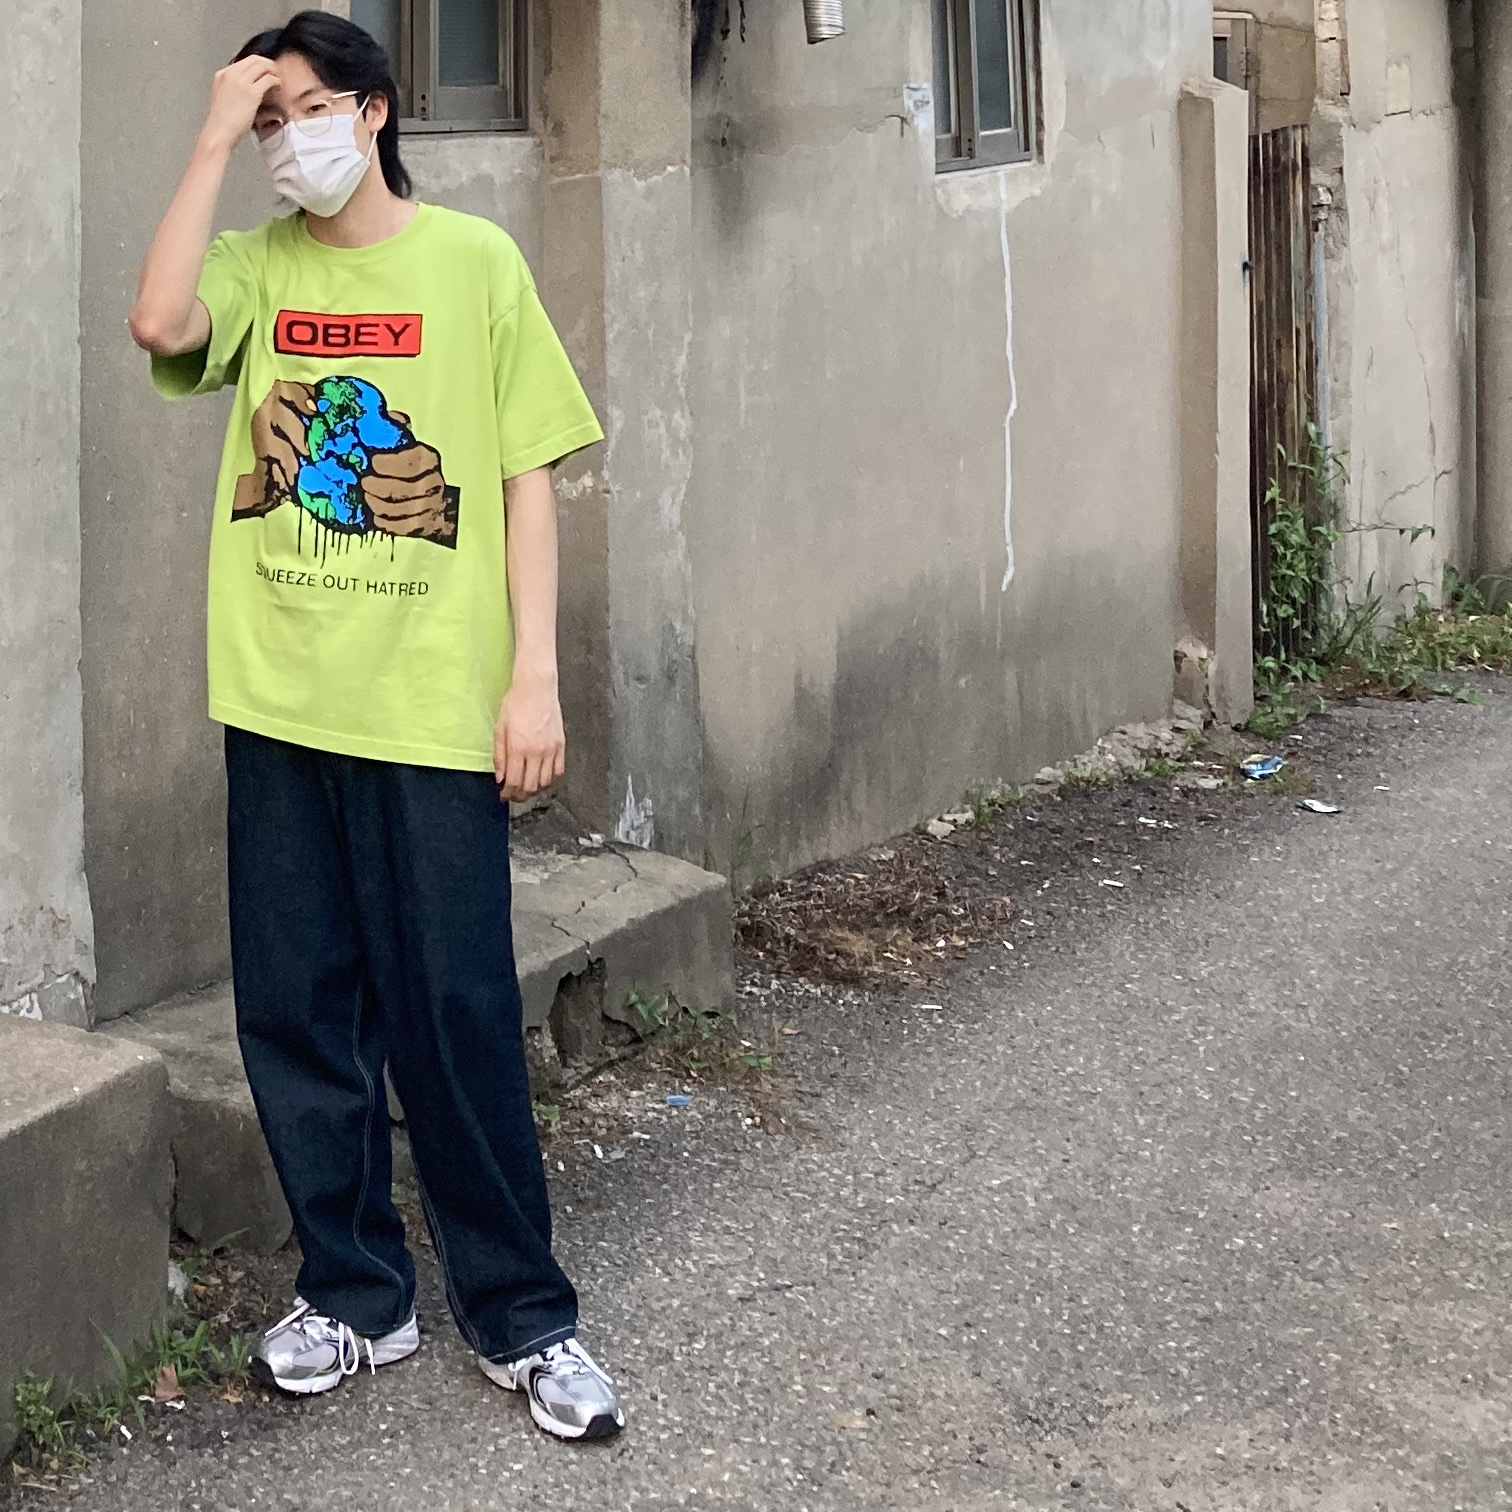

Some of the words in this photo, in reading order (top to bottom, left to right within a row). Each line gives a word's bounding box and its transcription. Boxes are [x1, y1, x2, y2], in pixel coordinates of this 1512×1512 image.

[287, 320, 412, 347] OBEY
[322, 574, 360, 592] OUT
[366, 579, 429, 597] HATRED
